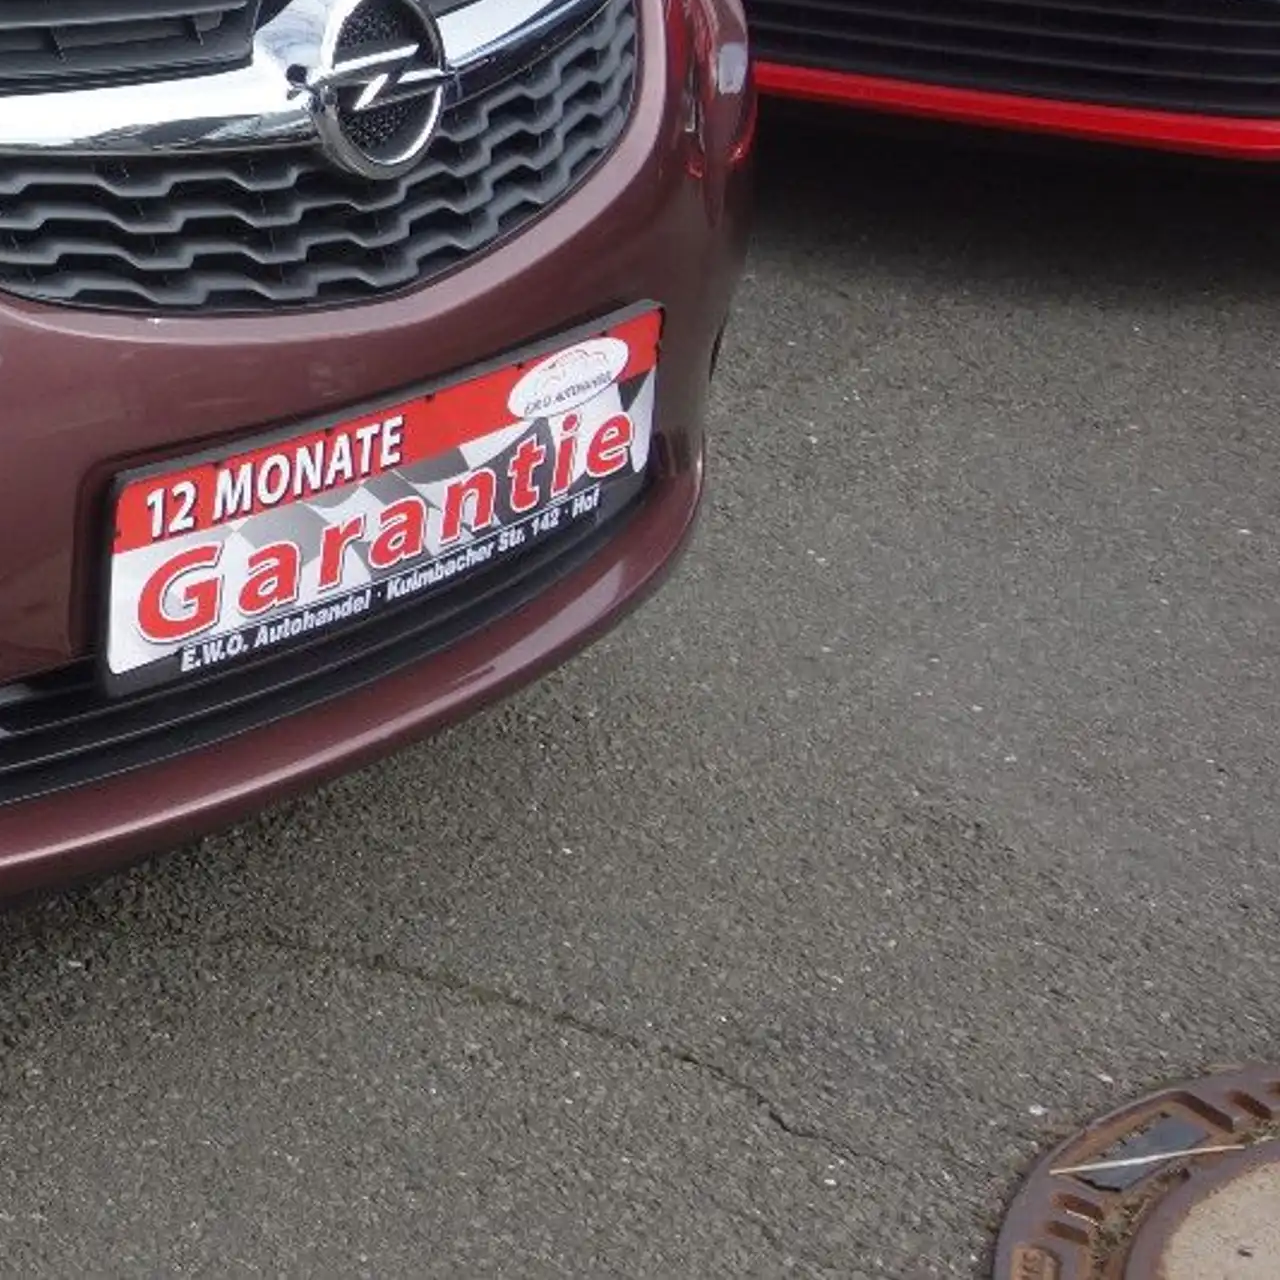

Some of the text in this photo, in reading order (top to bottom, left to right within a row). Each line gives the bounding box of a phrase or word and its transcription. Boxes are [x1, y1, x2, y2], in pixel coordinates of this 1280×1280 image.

[136, 410, 635, 643] Garantie
[144, 414, 406, 540] 12 MONATE
[180, 488, 601, 673] E.W.O. Autohandel Kulmbacher Str. 142 Hof
